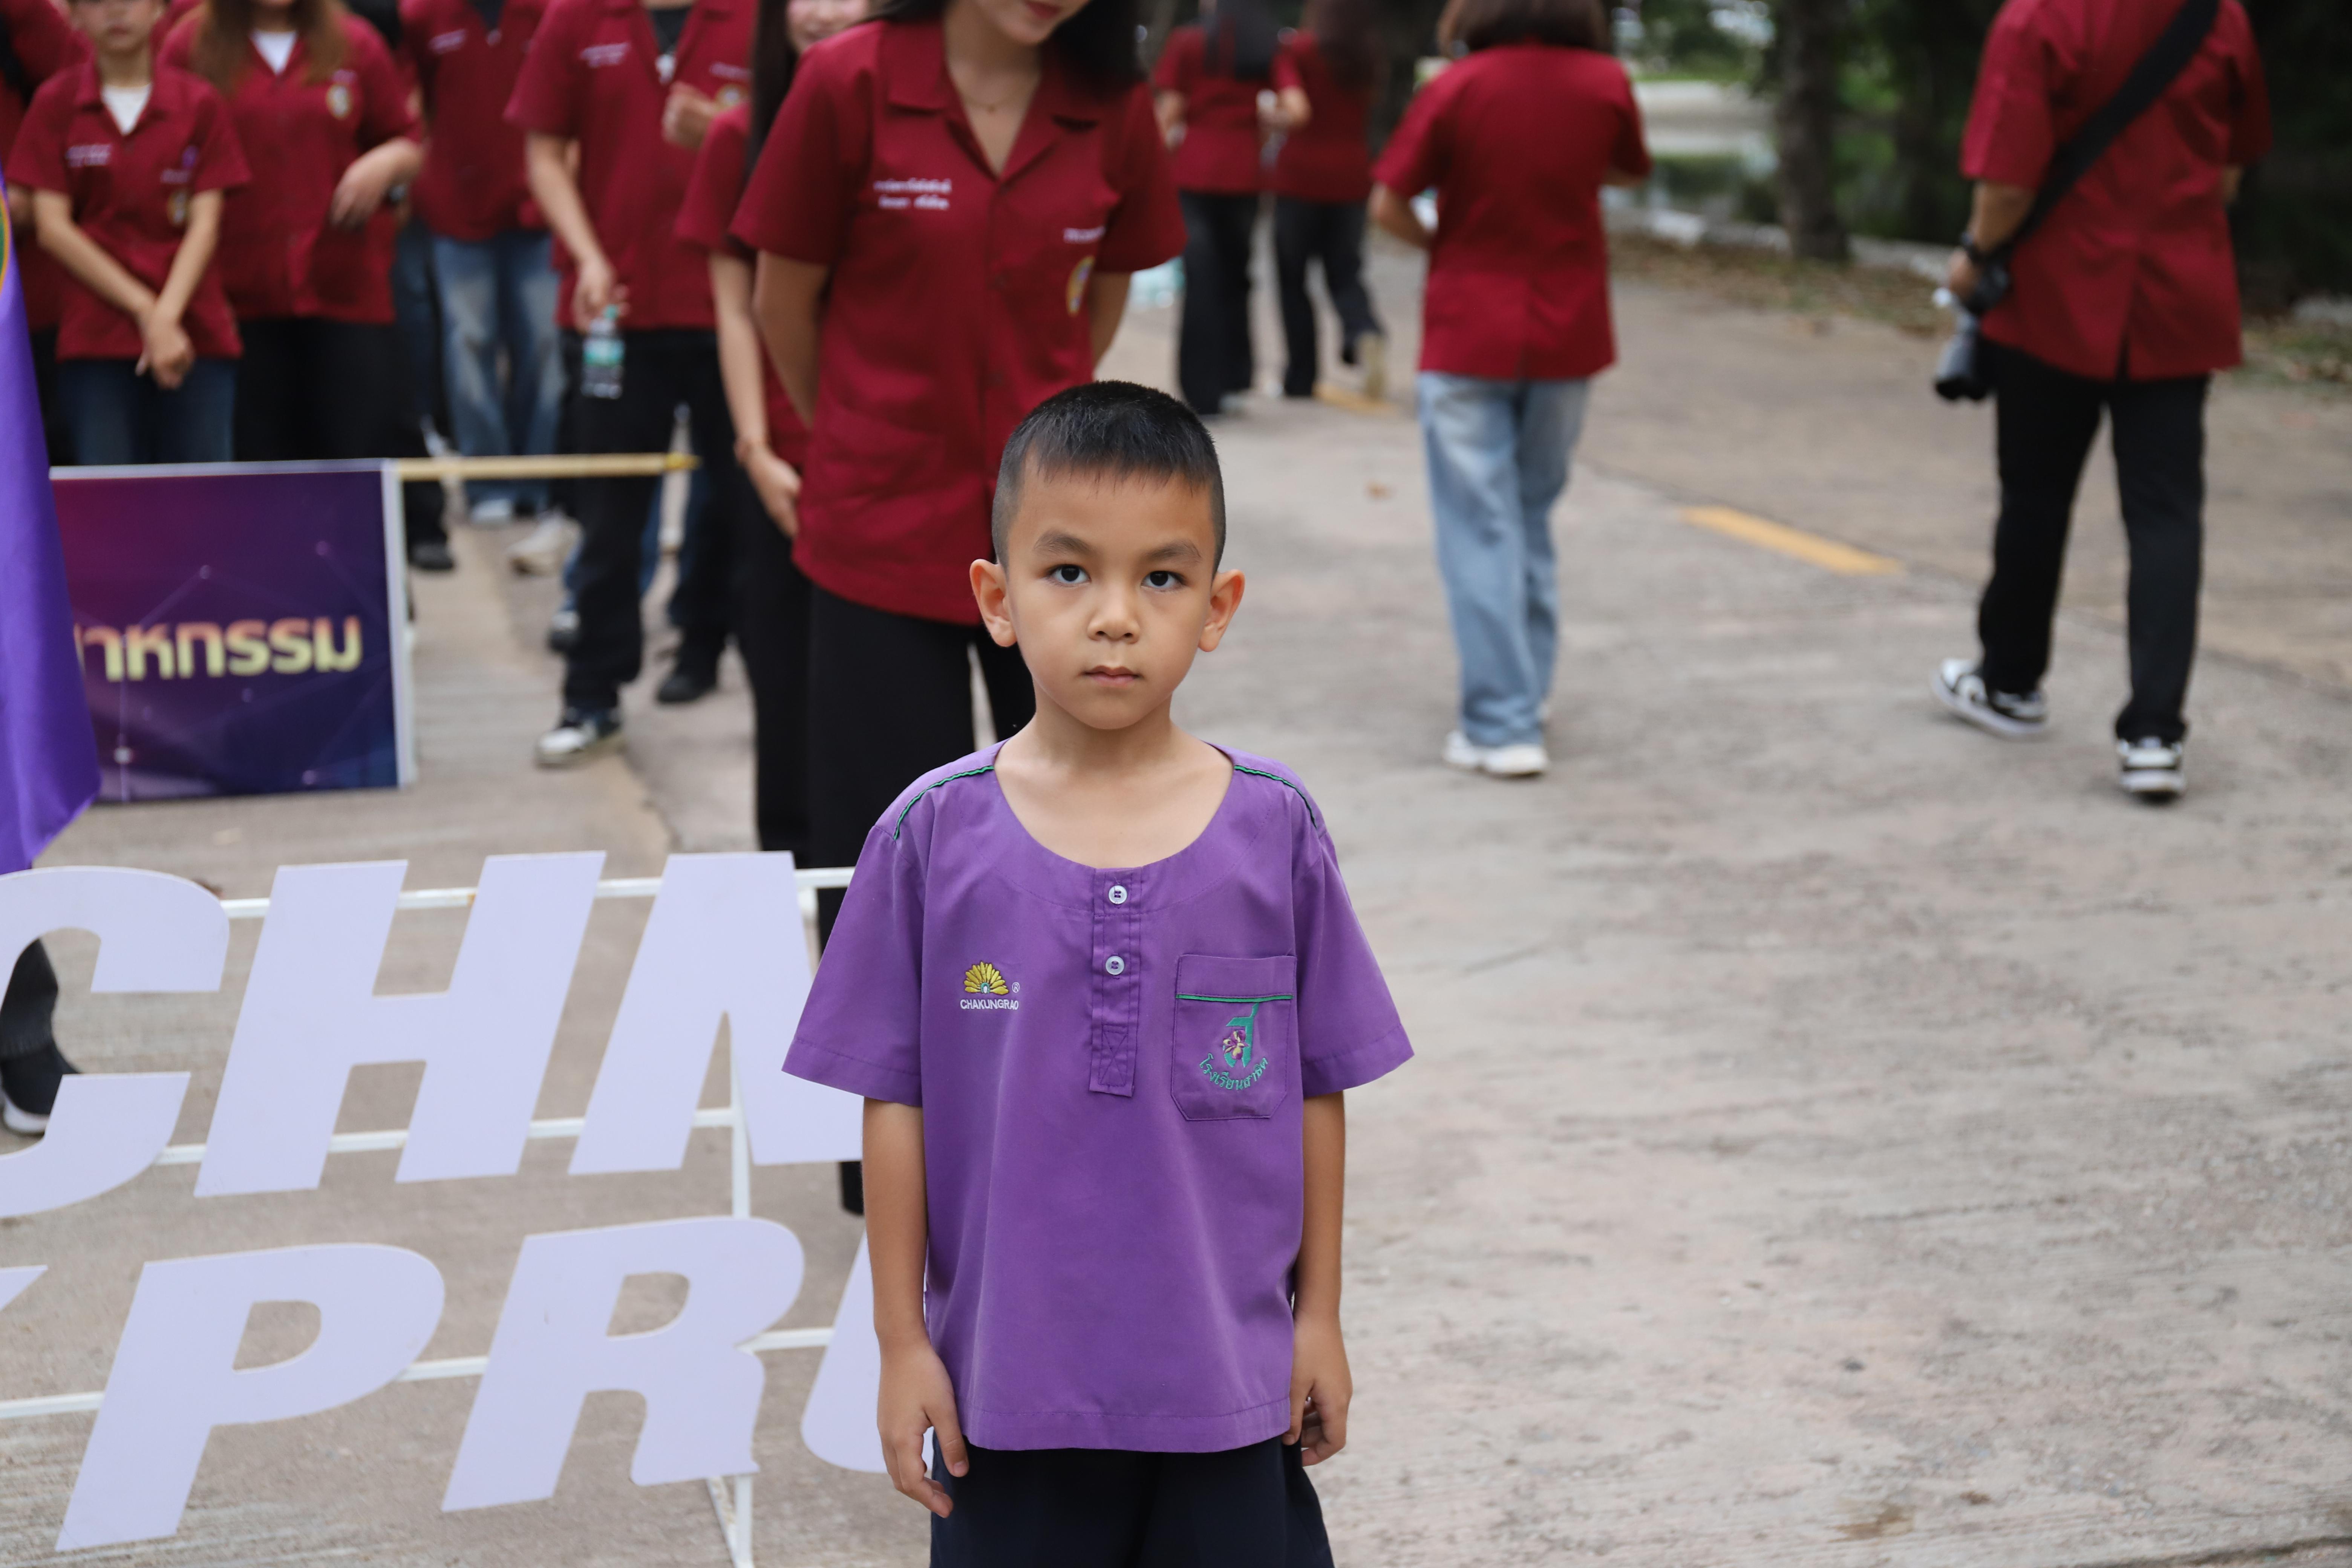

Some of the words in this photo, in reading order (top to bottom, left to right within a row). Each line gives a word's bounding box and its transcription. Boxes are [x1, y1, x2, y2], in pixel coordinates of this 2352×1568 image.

[74, 614, 363, 683] าหกรรม
[960, 999, 1019, 1010] CHAKUNGRAO
[1199, 1053, 1269, 1090] โรงเรียนสาธิต
